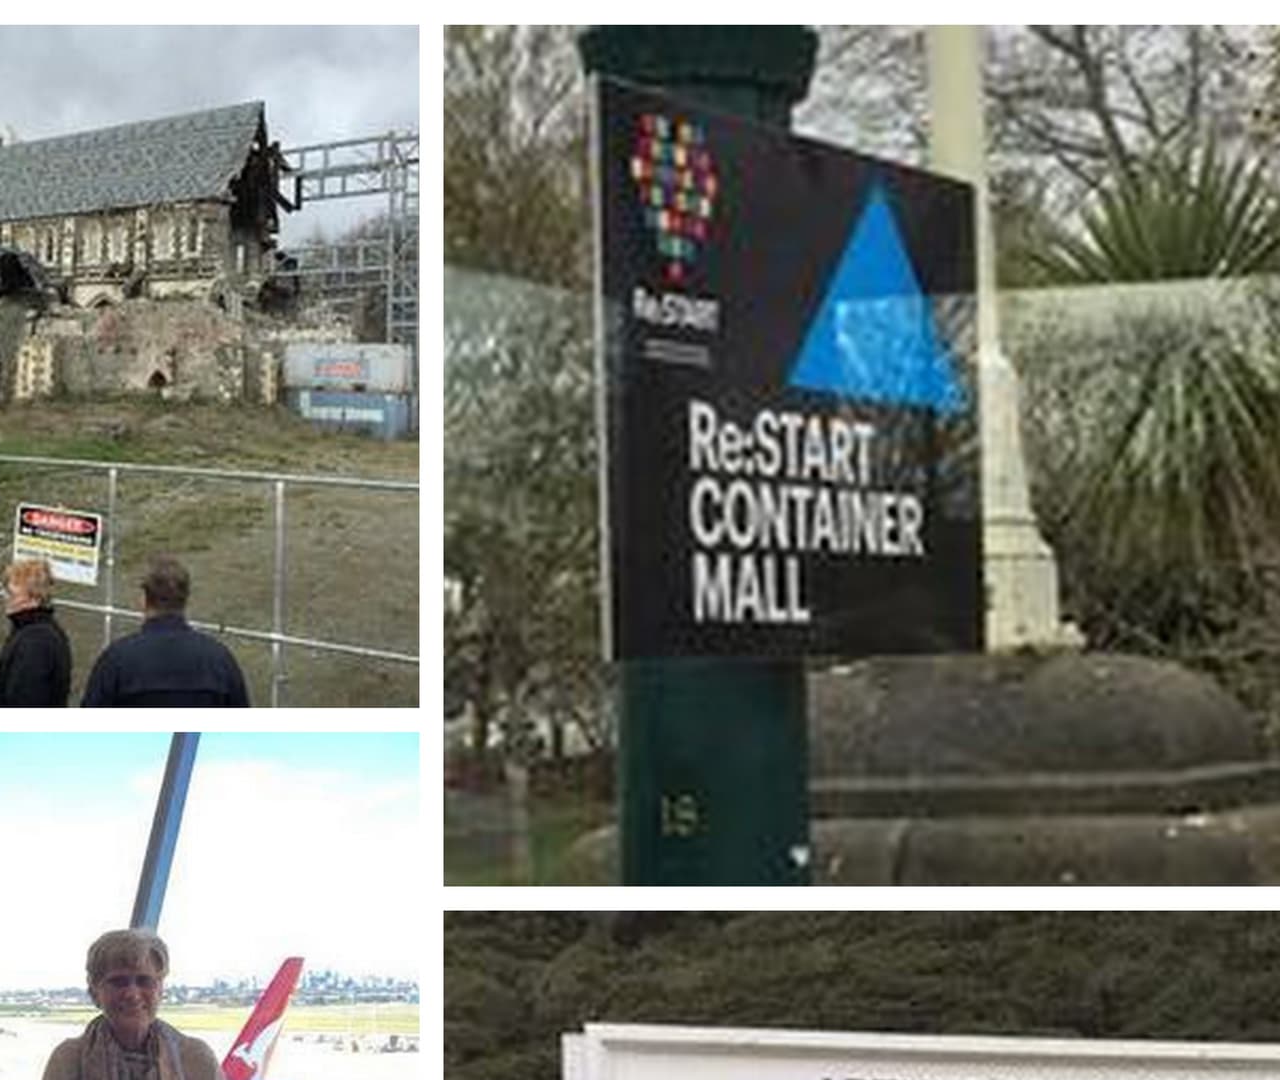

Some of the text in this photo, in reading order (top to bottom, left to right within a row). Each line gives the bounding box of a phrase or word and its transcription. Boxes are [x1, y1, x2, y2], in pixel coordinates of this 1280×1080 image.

[689, 403, 873, 484] Re:START
[690, 477, 924, 555] CONTAINER
[693, 553, 812, 622] MALL
